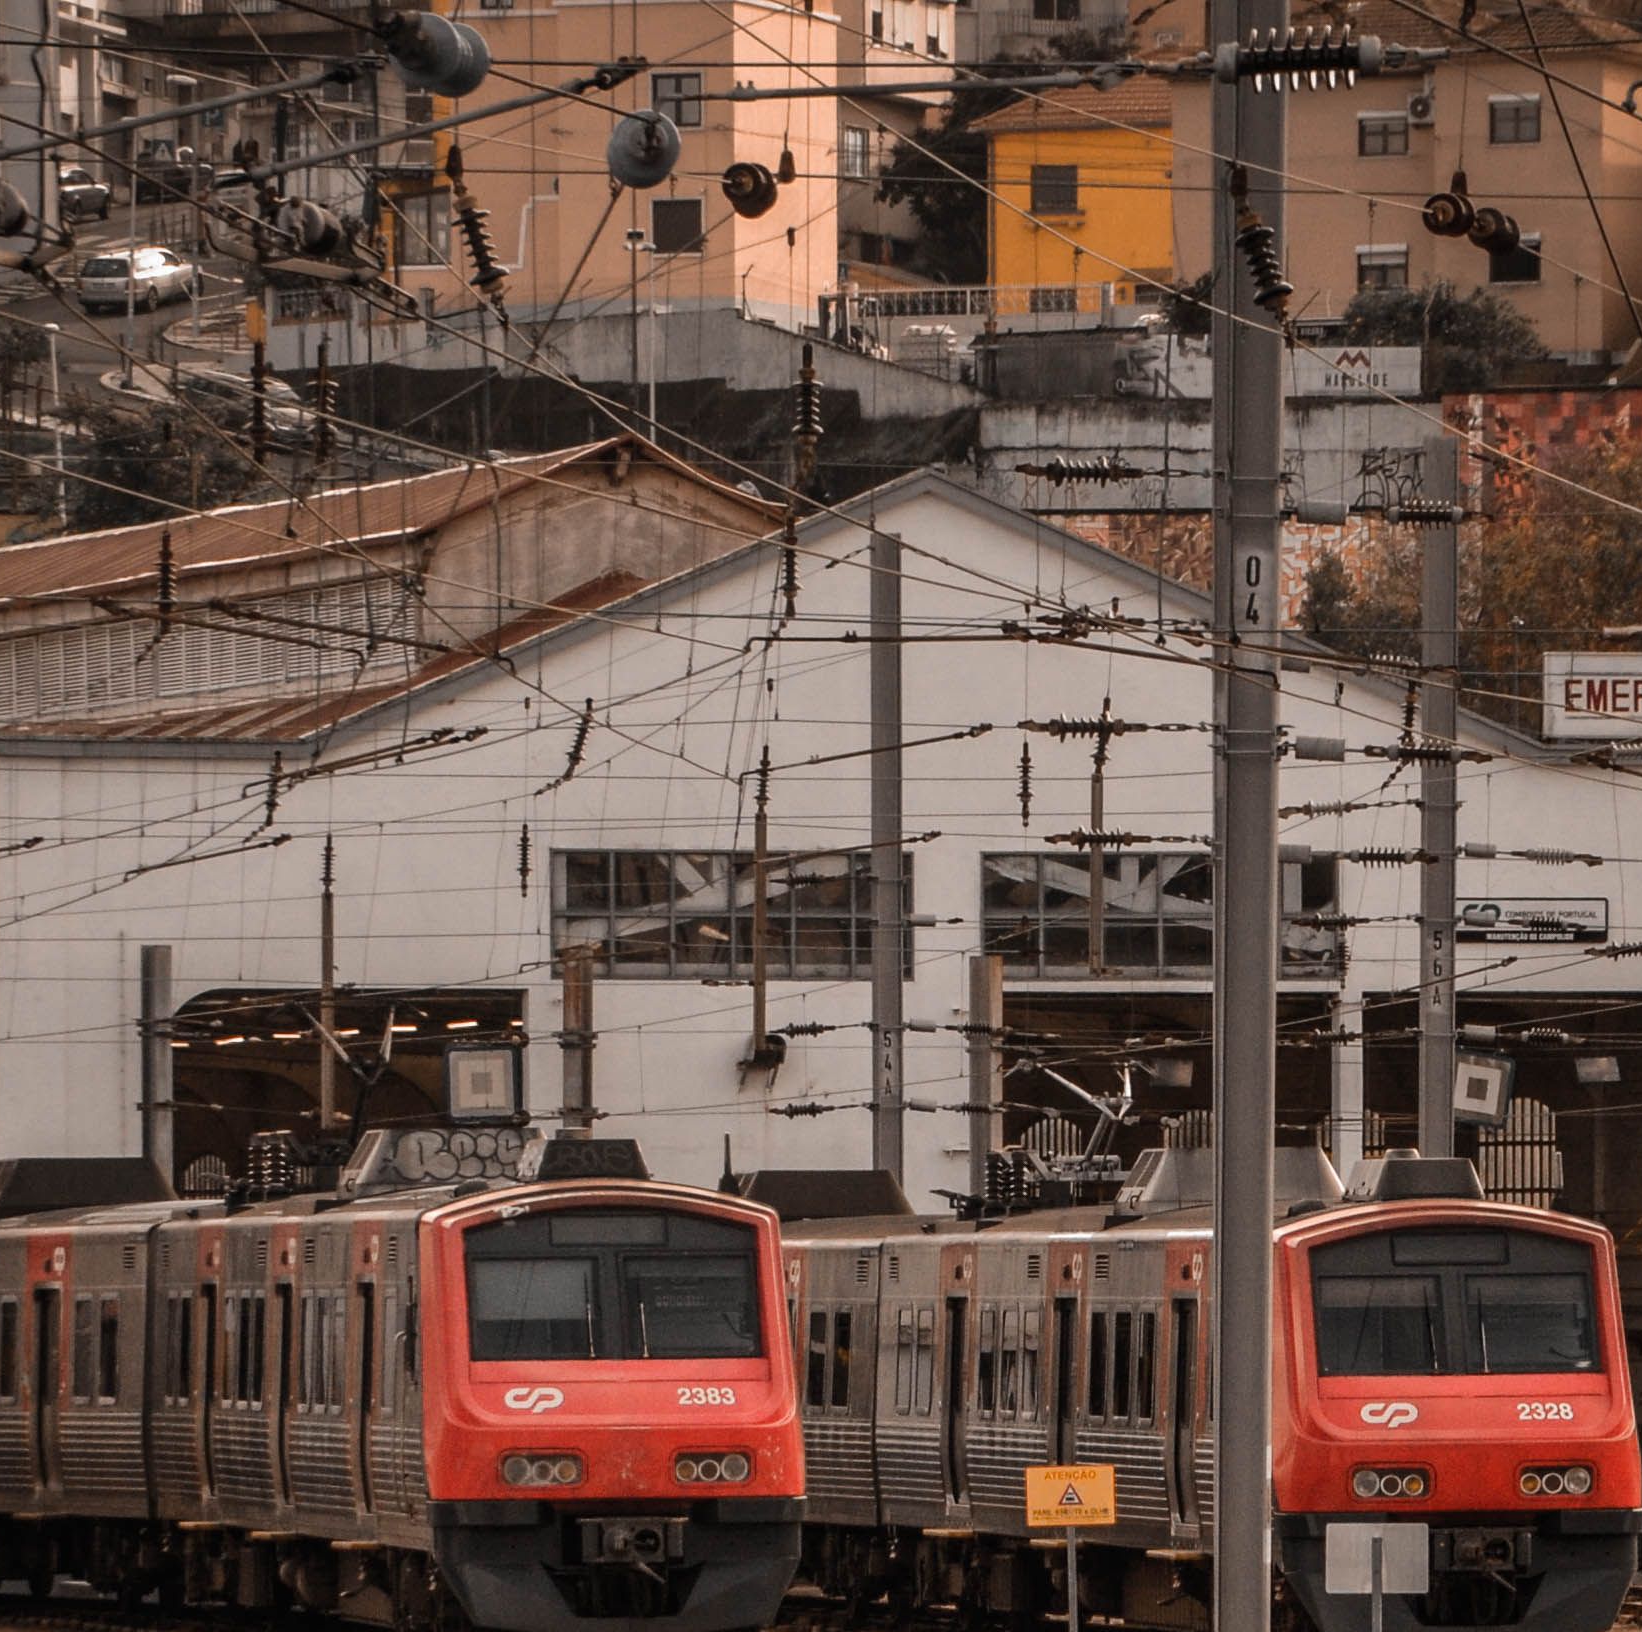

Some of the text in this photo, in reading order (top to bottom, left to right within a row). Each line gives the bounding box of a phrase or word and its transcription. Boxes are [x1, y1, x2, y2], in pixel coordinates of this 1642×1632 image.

[1246, 555, 1261, 625] 04
[504, 1387, 564, 1413] CP
[677, 1387, 736, 1406] 2383
[1360, 1402, 1419, 1428] CP
[1516, 1402, 1574, 1421] 2328
